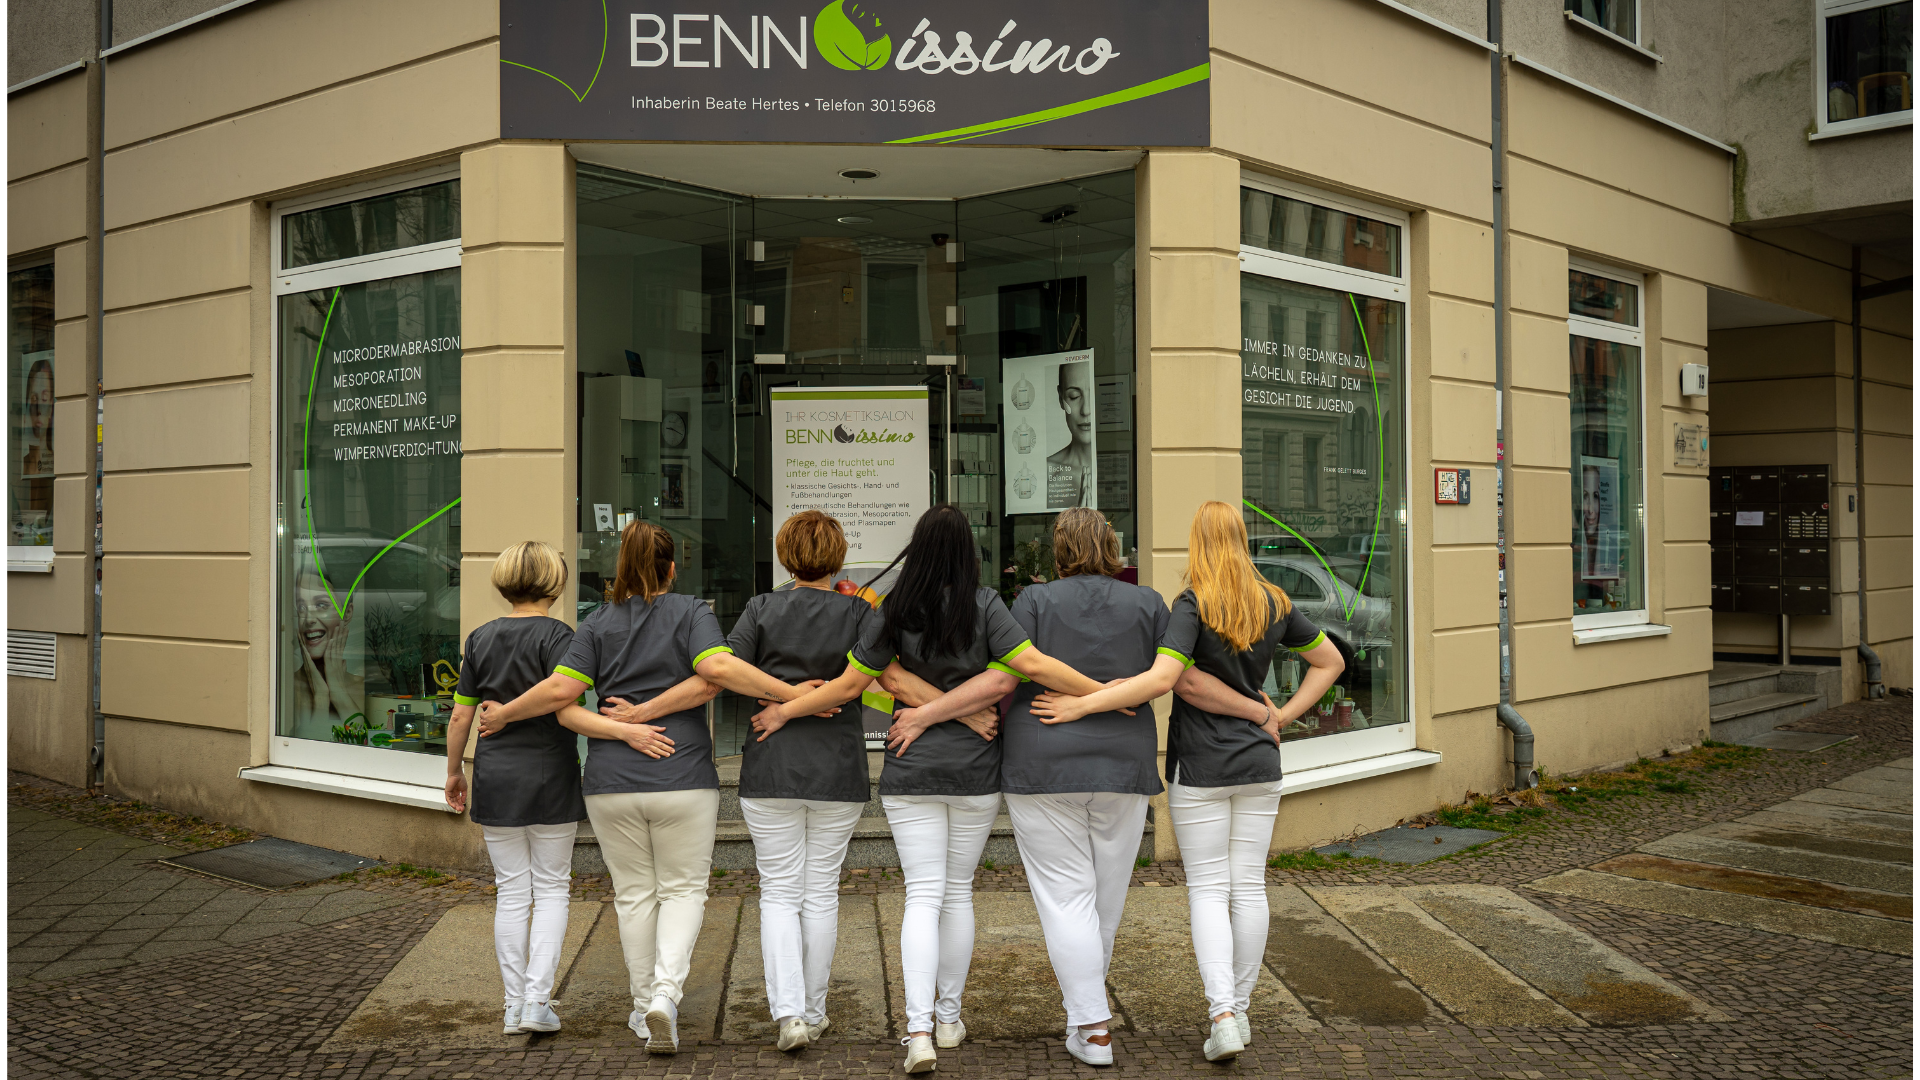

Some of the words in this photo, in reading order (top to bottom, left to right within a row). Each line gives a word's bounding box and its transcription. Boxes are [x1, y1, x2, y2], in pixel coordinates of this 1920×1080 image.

[631, 96, 700, 110] Inhaberin
[705, 97, 747, 111] Beate
[752, 98, 800, 111] Hertes
[815, 98, 865, 112] Telefon
[870, 99, 936, 113] 3015968
[333, 335, 461, 364] MICRODERMABRASION
[1244, 338, 1278, 356] IMMER
[1282, 343, 1295, 358] IN
[1298, 346, 1351, 367] GEDANKEN
[1354, 355, 1367, 369] ZU
[333, 366, 422, 389] MESOPORATION
[1244, 362, 1297, 385] LÄCHELN,
[1300, 371, 1337, 388] ERHÄLT
[1341, 376, 1361, 391] DEM
[333, 391, 428, 413] MICRONEEDLING
[1244, 389, 1292, 407] GESICHT
[1295, 394, 1312, 409] DIE
[1316, 397, 1356, 414] JUGEND.
[785, 411, 806, 423] IHR
[809, 410, 914, 422] KOSMETIKSALON
[333, 418, 399, 437] PERMANENT
[403, 414, 457, 432] MAKE-UP
[786, 458, 818, 469] Pflege,
[820, 458, 835, 467] die
[837, 458, 874, 467] fruchtet
[877, 457, 895, 467] und
[786, 469, 811, 478] unter
[813, 468, 828, 477] die
[831, 468, 853, 477] Haut
[855, 468, 879, 479] geht.
[790, 482, 826, 490] klassische
[827, 482, 862, 490] Gesichts-,
[790, 491, 852, 500] Fußbehandlungen
[790, 502, 846, 510] dermazeutische
[847, 501, 897, 511] Behandlungen
[862, 510, 911, 518] Mesoporation,
